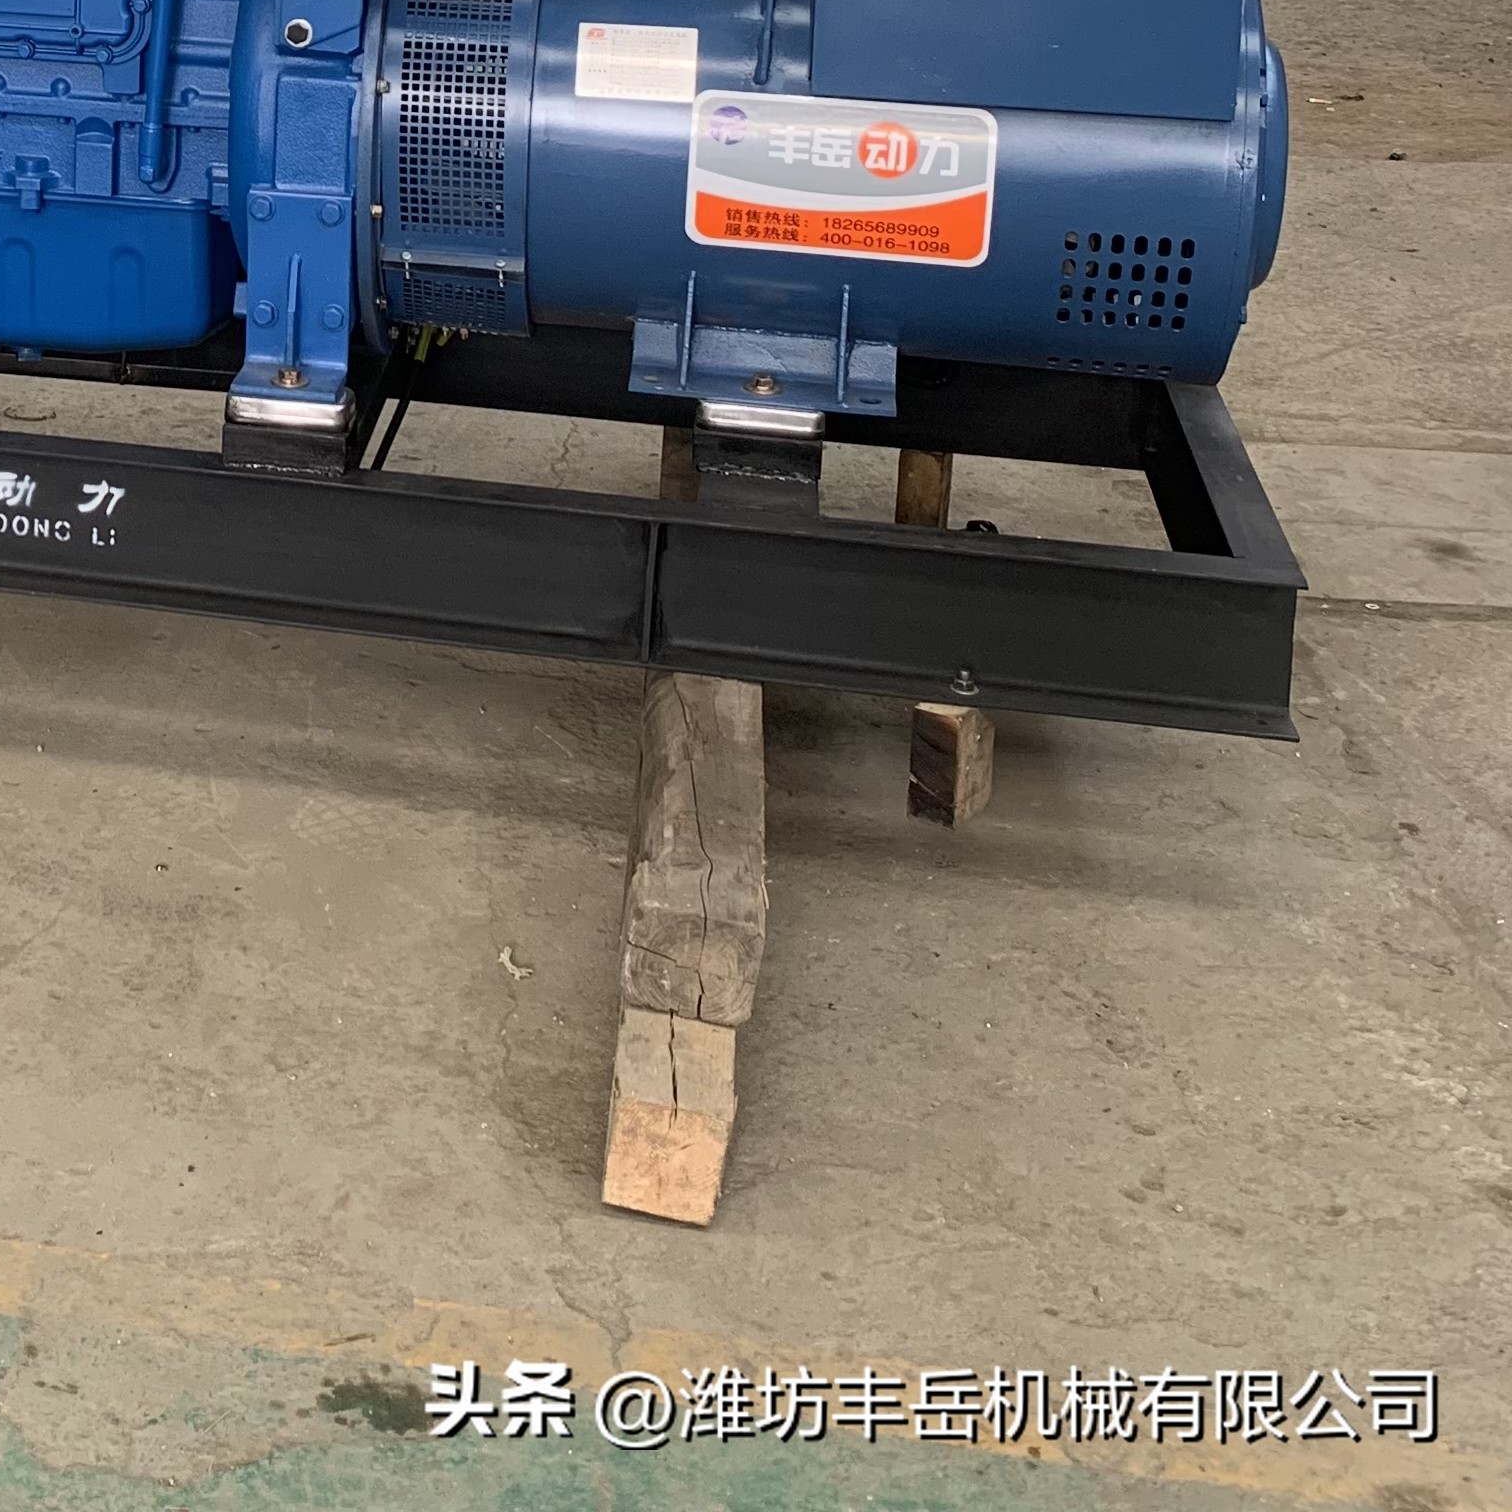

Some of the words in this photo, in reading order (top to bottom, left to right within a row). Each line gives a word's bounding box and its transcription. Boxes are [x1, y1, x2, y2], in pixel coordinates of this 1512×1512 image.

[767, 125, 960, 178] 丰岳动力
[822, 217, 940, 238] 18265689909
[819, 232, 950, 254] 400-016-1098
